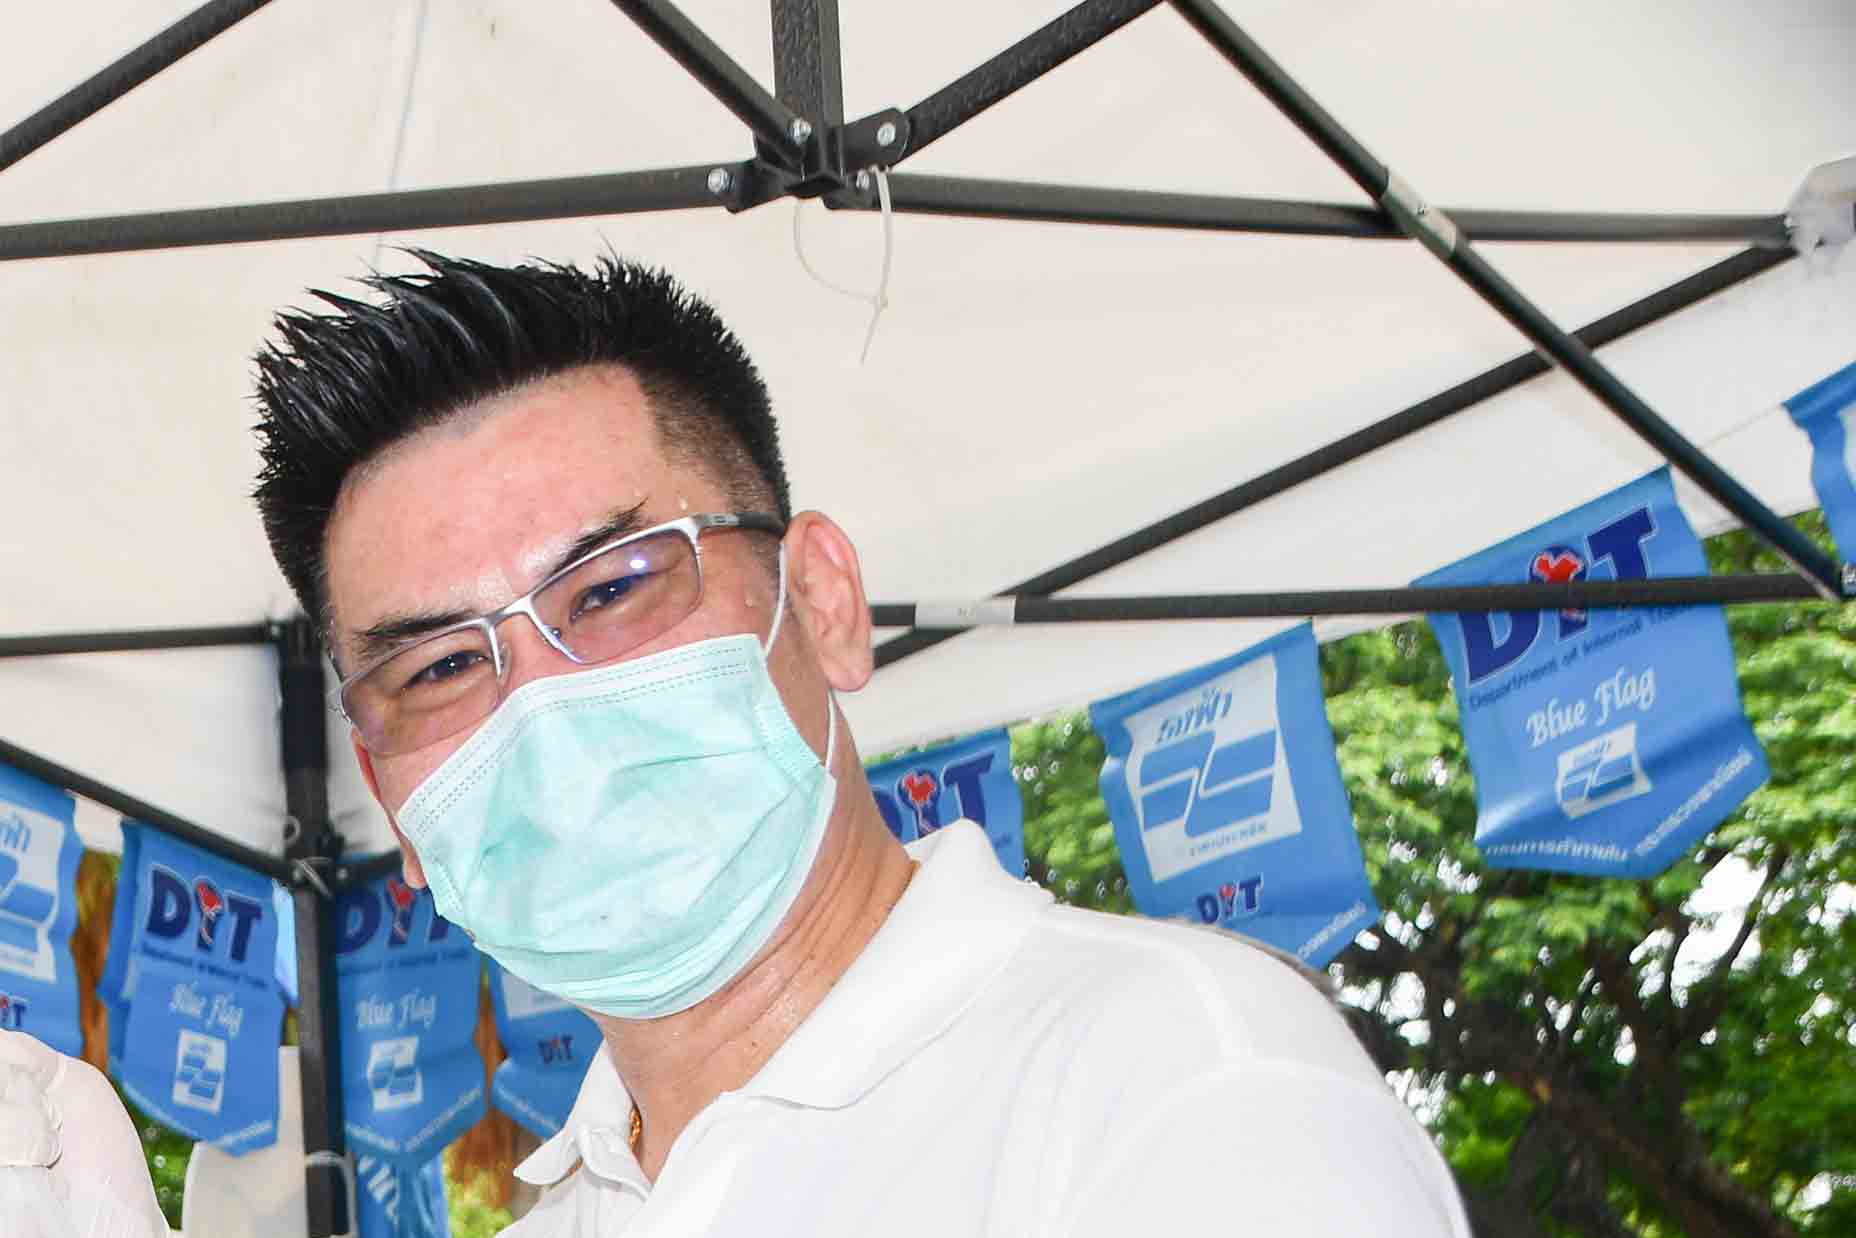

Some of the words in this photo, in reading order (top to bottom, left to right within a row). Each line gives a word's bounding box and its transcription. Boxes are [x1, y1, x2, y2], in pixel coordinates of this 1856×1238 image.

[1526, 699, 1585, 747] Blue
[1593, 665, 1656, 726] Flag
[146, 867, 263, 964] DIT
